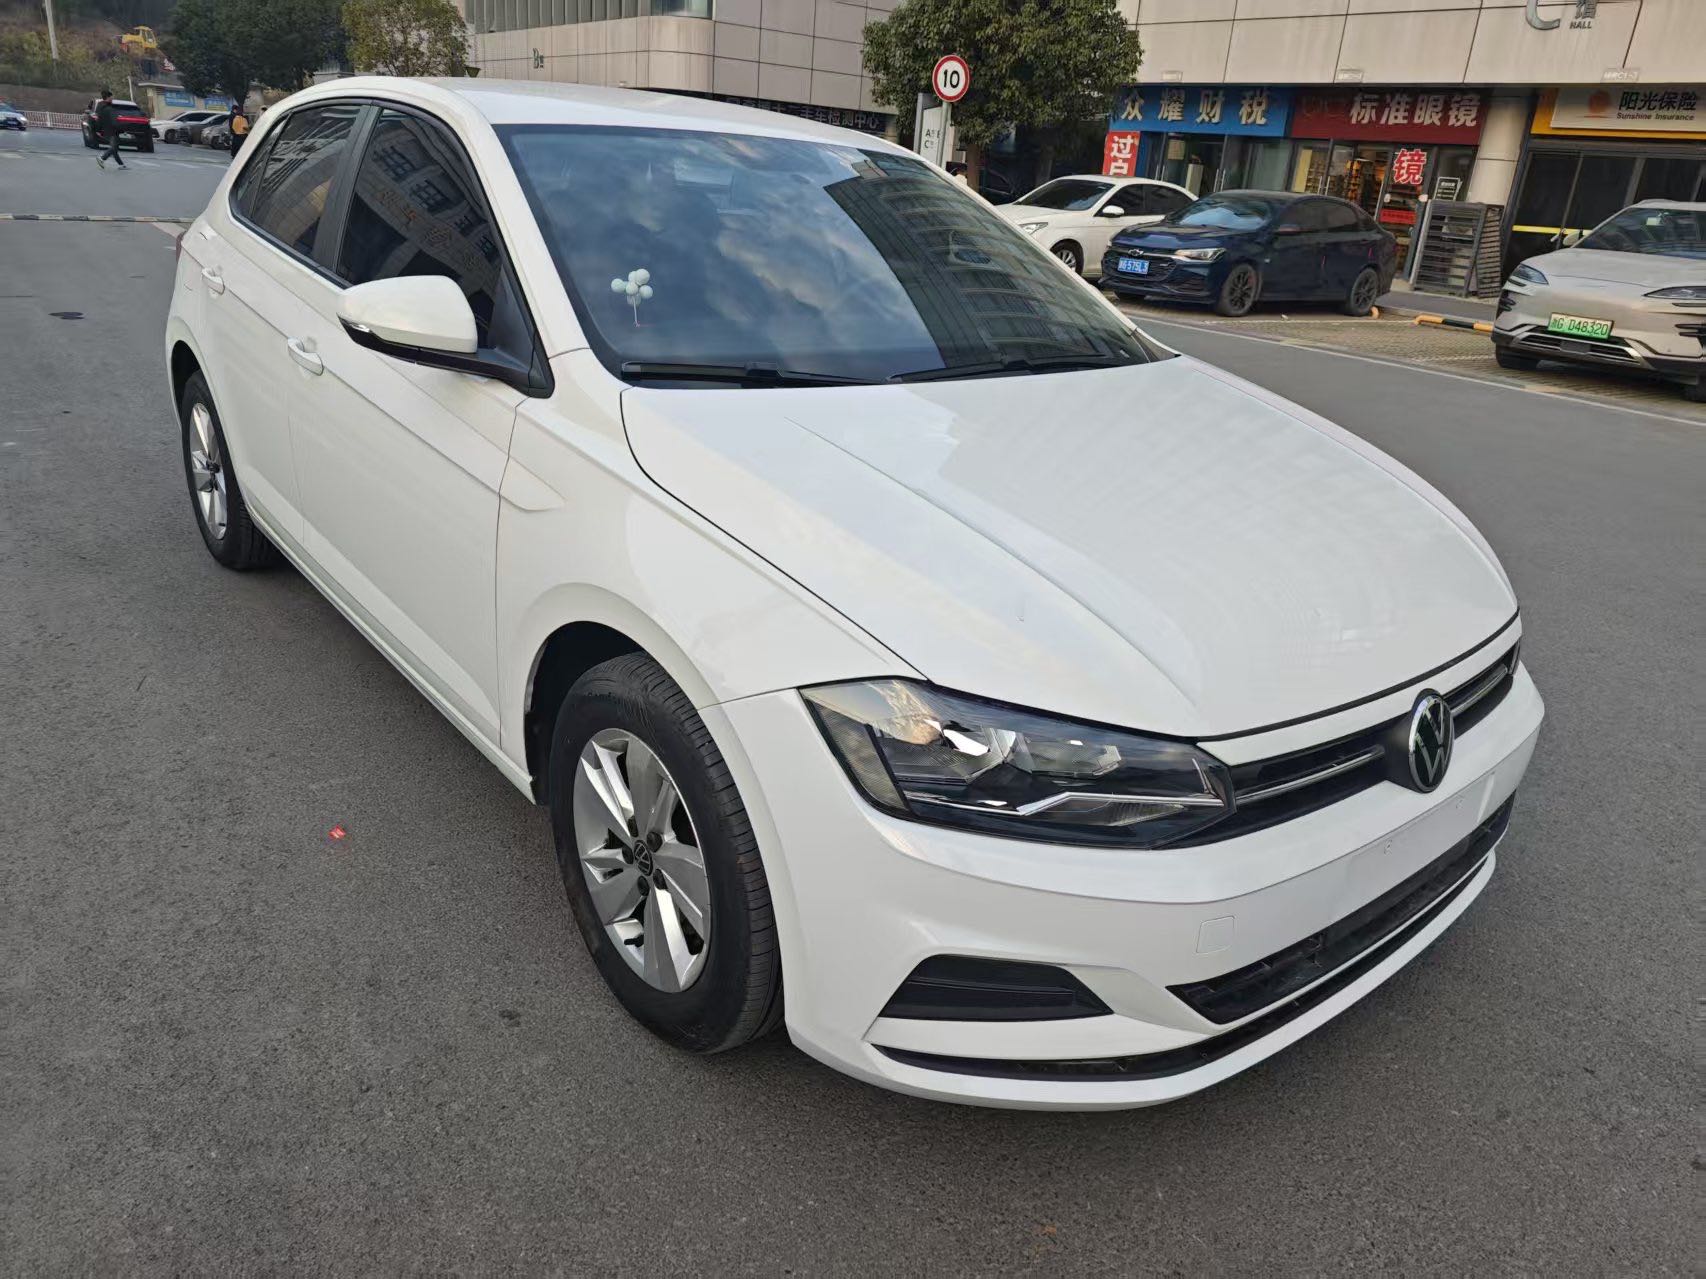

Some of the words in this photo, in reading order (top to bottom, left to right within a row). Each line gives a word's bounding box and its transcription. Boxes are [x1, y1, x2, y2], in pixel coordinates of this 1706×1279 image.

[1569, 20, 1593, 30] HALL
[943, 69, 960, 89] 10
[1120, 88, 1271, 126] 众耀财税
[1350, 92, 1480, 127] 标准眼镜
[1618, 90, 1697, 111] 阳光保险
[1616, 111, 1651, 121] Sunshine
[1654, 113, 1695, 121] Insurance
[1393, 148, 1427, 185] 镜
